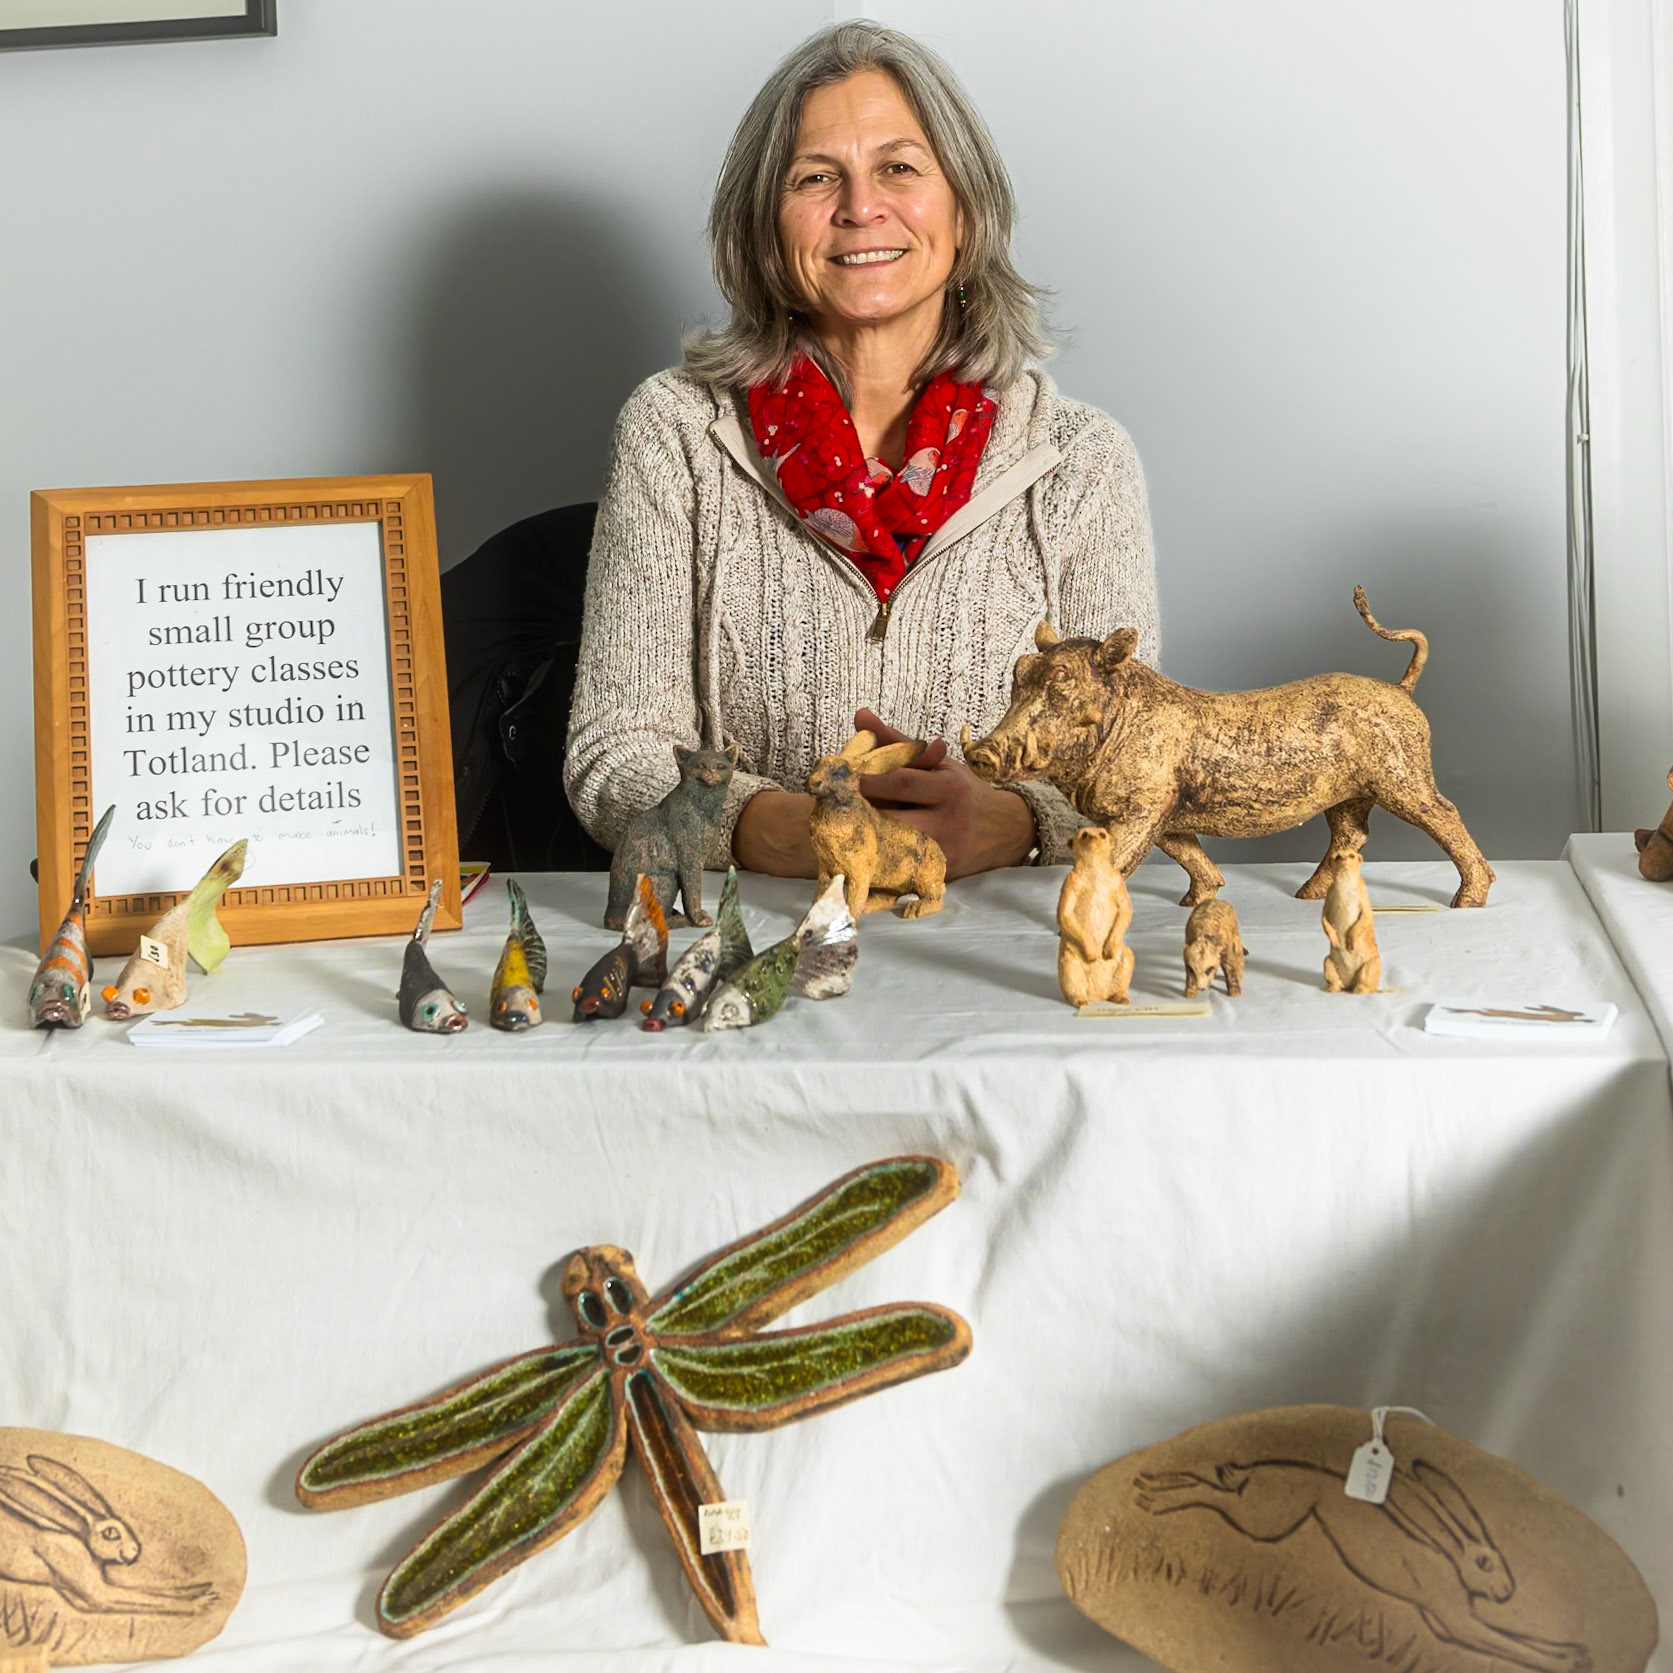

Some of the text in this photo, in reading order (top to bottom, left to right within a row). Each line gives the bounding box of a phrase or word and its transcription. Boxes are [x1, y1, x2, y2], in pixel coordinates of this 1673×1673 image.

[136, 569, 344, 604] I run friendly
[149, 615, 335, 648] small group
[127, 655, 359, 697] pottery classes
[126, 694, 366, 736] in my studio in
[123, 740, 370, 777] Totland. Please
[136, 781, 362, 820] ask for details
[128, 834, 152, 850] You
[167, 834, 195, 849] don't
[278, 831, 312, 840] make
[326, 821, 376, 838] animals!
